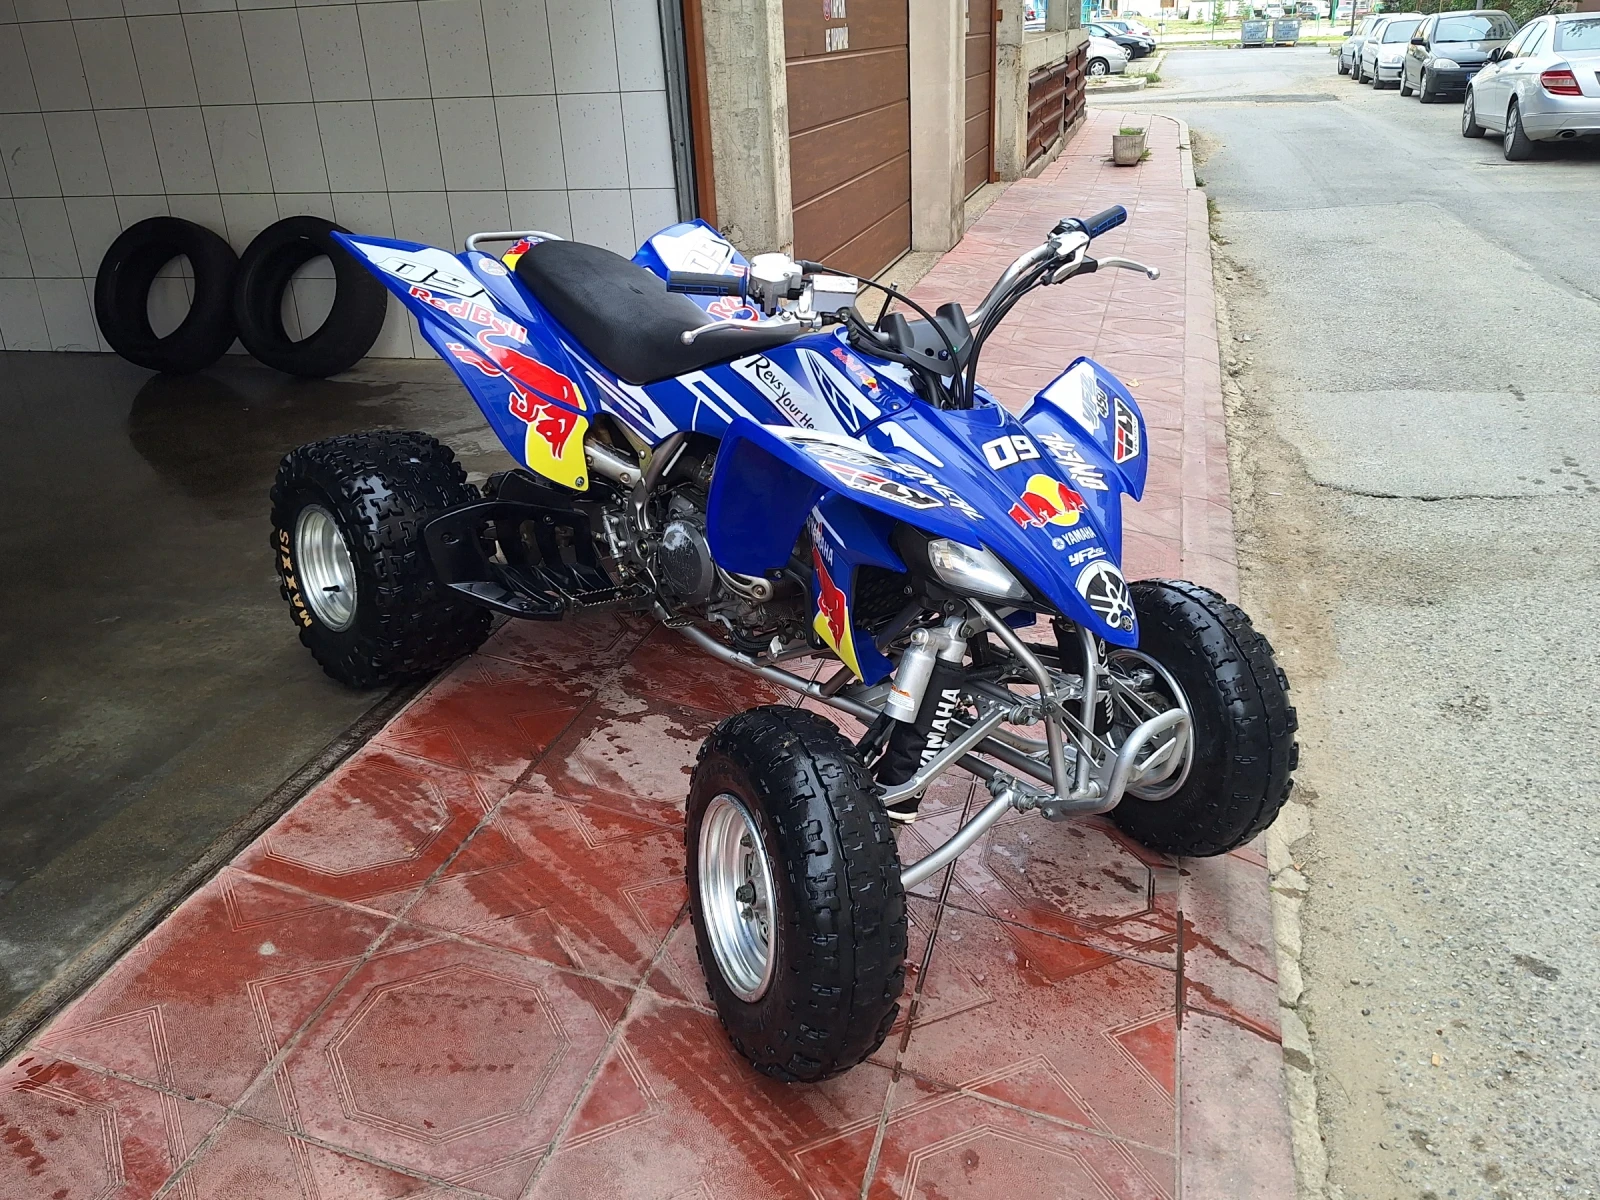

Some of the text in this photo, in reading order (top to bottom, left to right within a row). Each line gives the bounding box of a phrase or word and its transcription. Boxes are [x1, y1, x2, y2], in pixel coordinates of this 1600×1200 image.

[409, 285, 529, 344] Red Bull
[744, 355, 784, 390] Revs
[775, 387, 803, 417] Your
[981, 433, 1041, 471] 09
[1061, 526, 1097, 546] YAMAHA
[279, 528, 313, 628] MAXXIS
